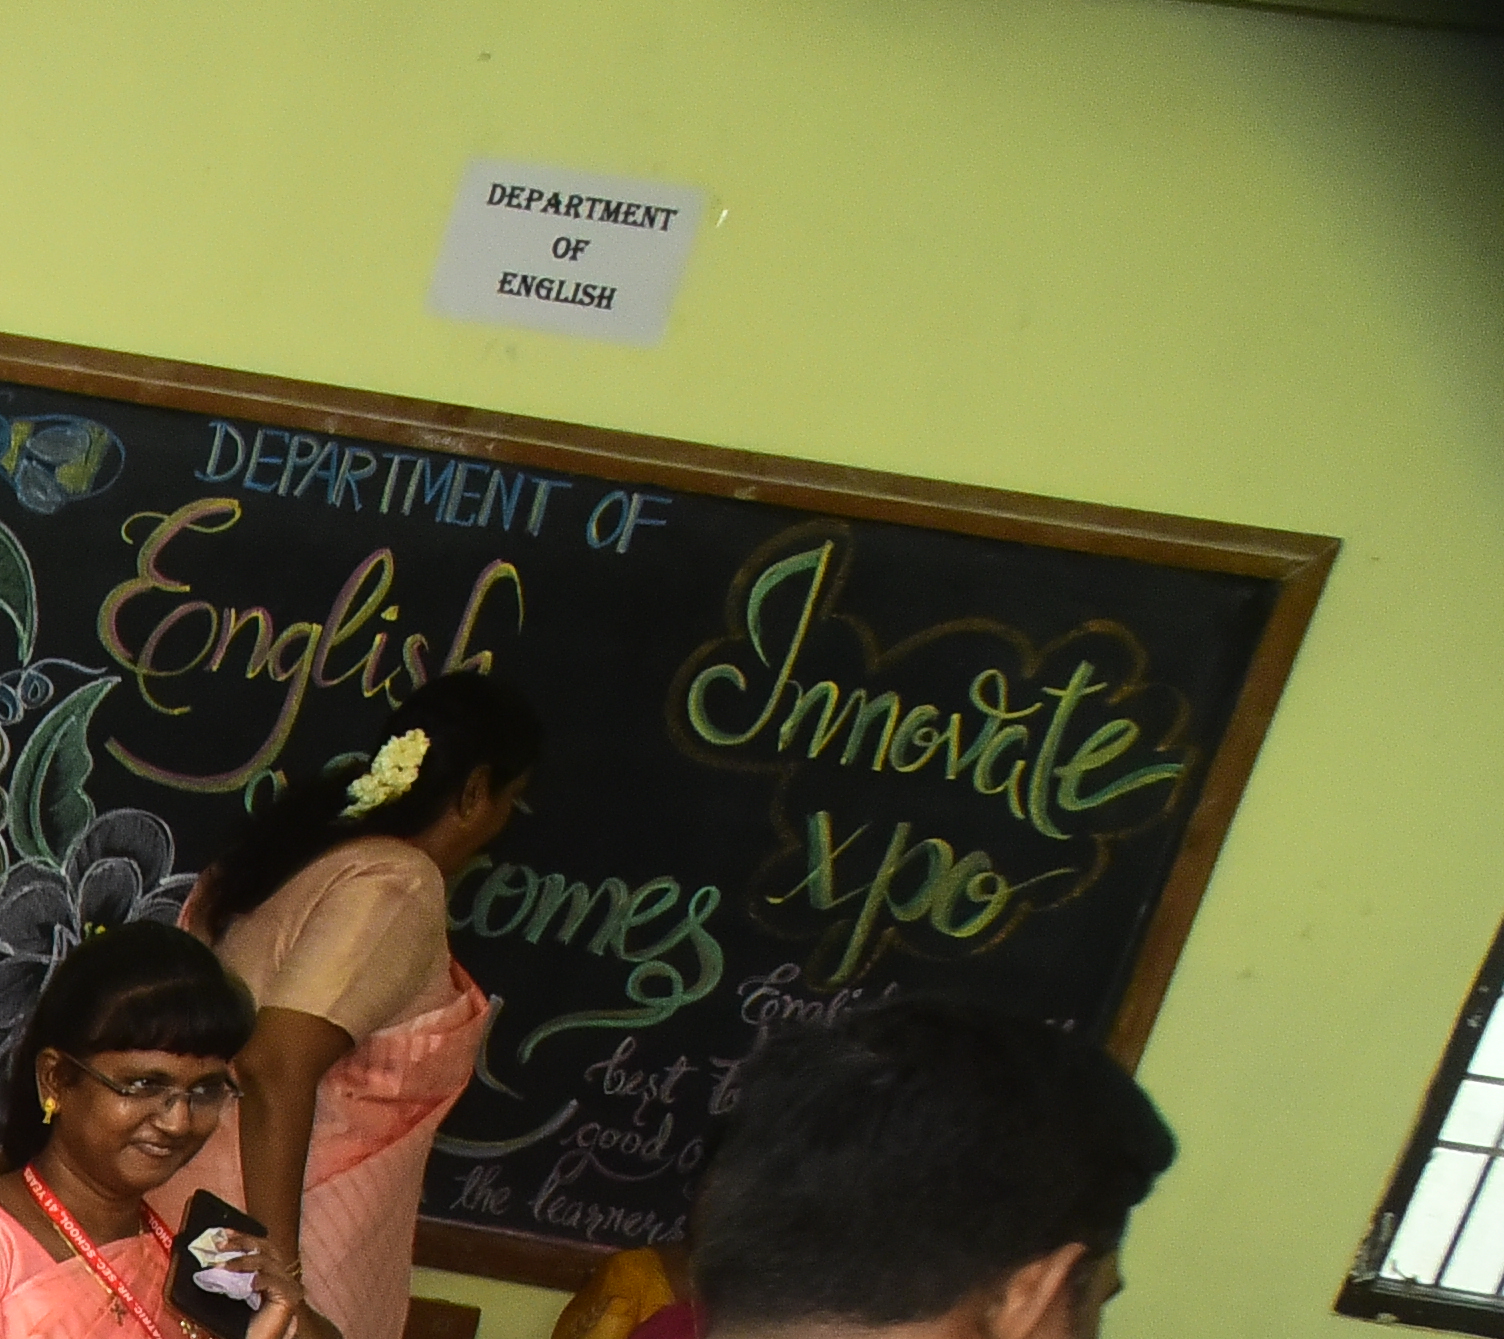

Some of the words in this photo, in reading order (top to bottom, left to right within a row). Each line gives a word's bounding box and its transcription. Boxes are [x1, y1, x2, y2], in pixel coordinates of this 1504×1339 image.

[486, 183, 678, 232] DEPARTMENT
[551, 236, 590, 262] OF
[496, 271, 617, 311] ENGLISH
[194, 418, 572, 538] DEPARTMENT
[587, 489, 674, 555] OF
[688, 539, 1187, 839] Innovate
[450, 1164, 512, 1216] the
